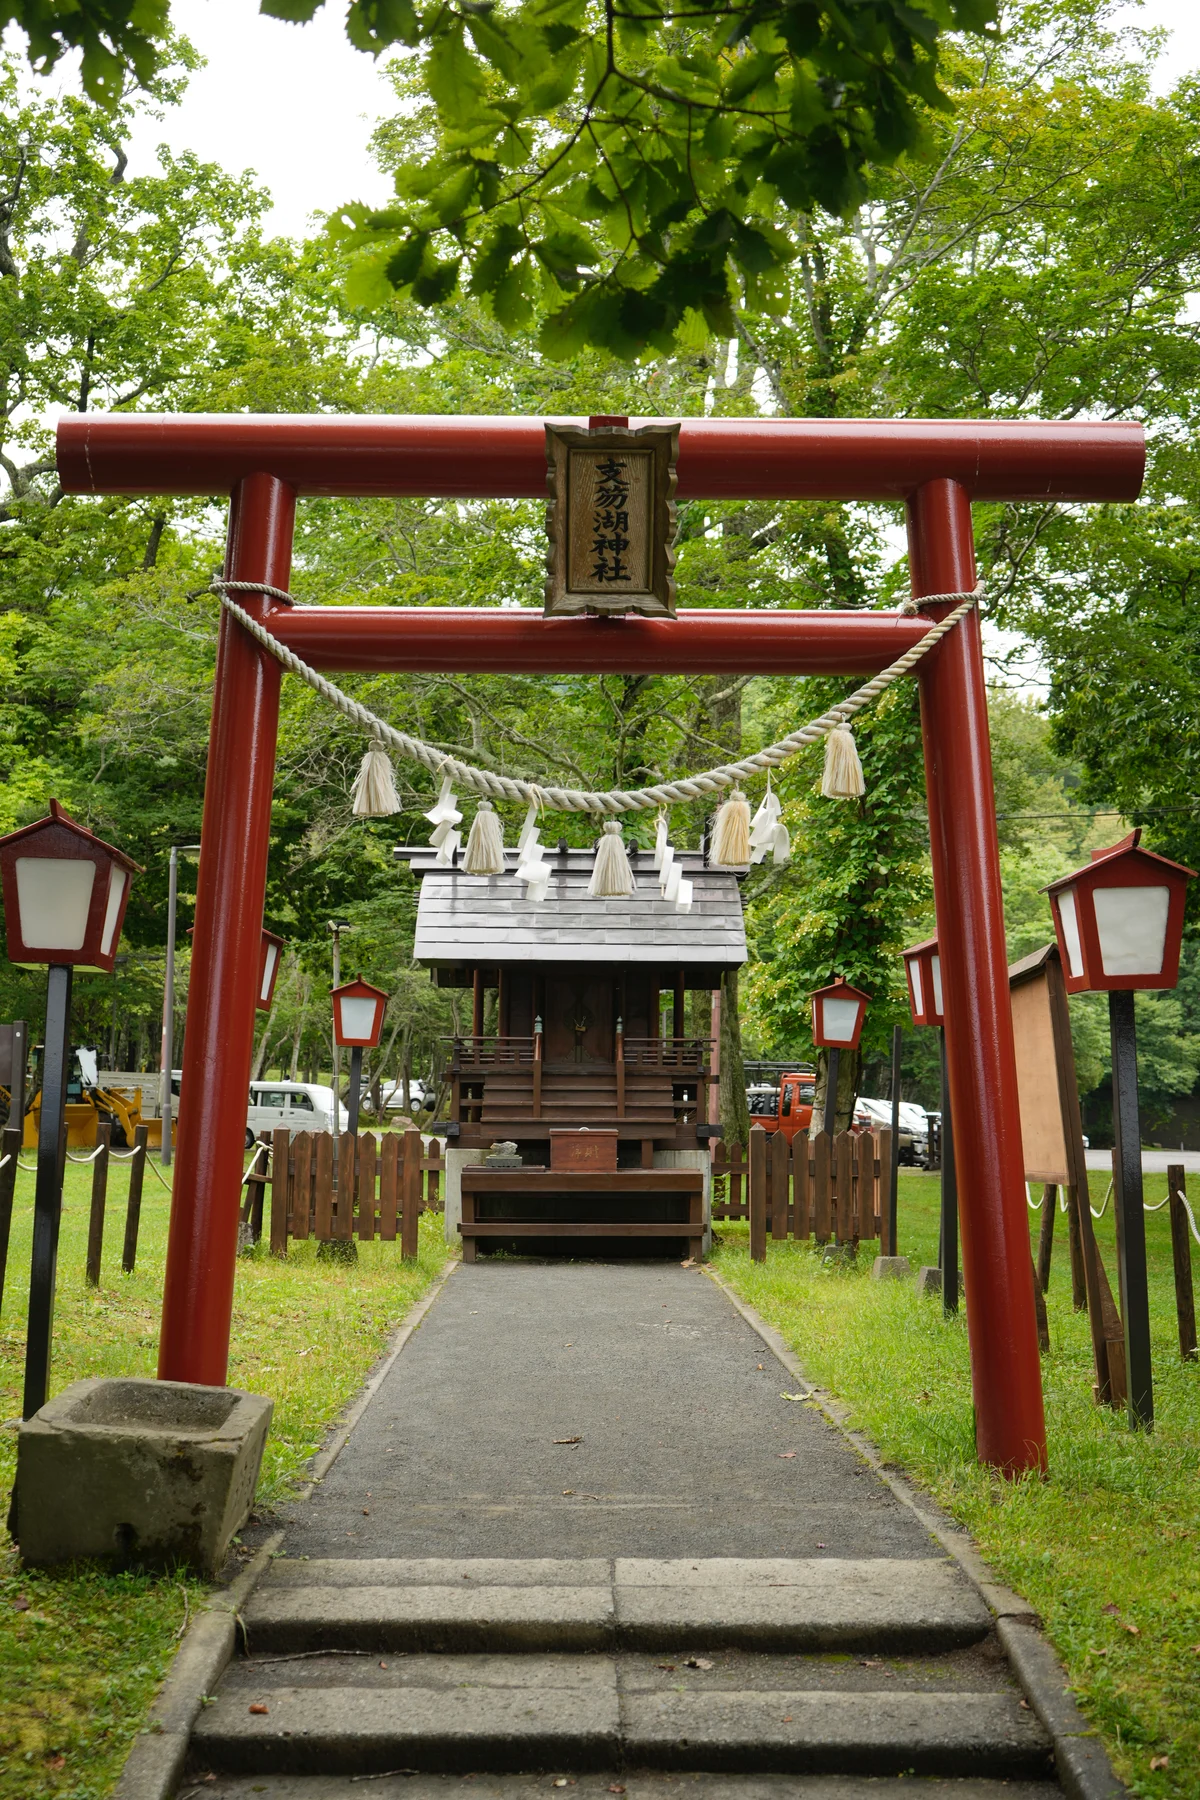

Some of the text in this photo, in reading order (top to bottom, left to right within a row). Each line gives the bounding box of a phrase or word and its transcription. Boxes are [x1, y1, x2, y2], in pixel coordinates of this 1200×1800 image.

[589, 458, 632, 582] 支笏湖神社
